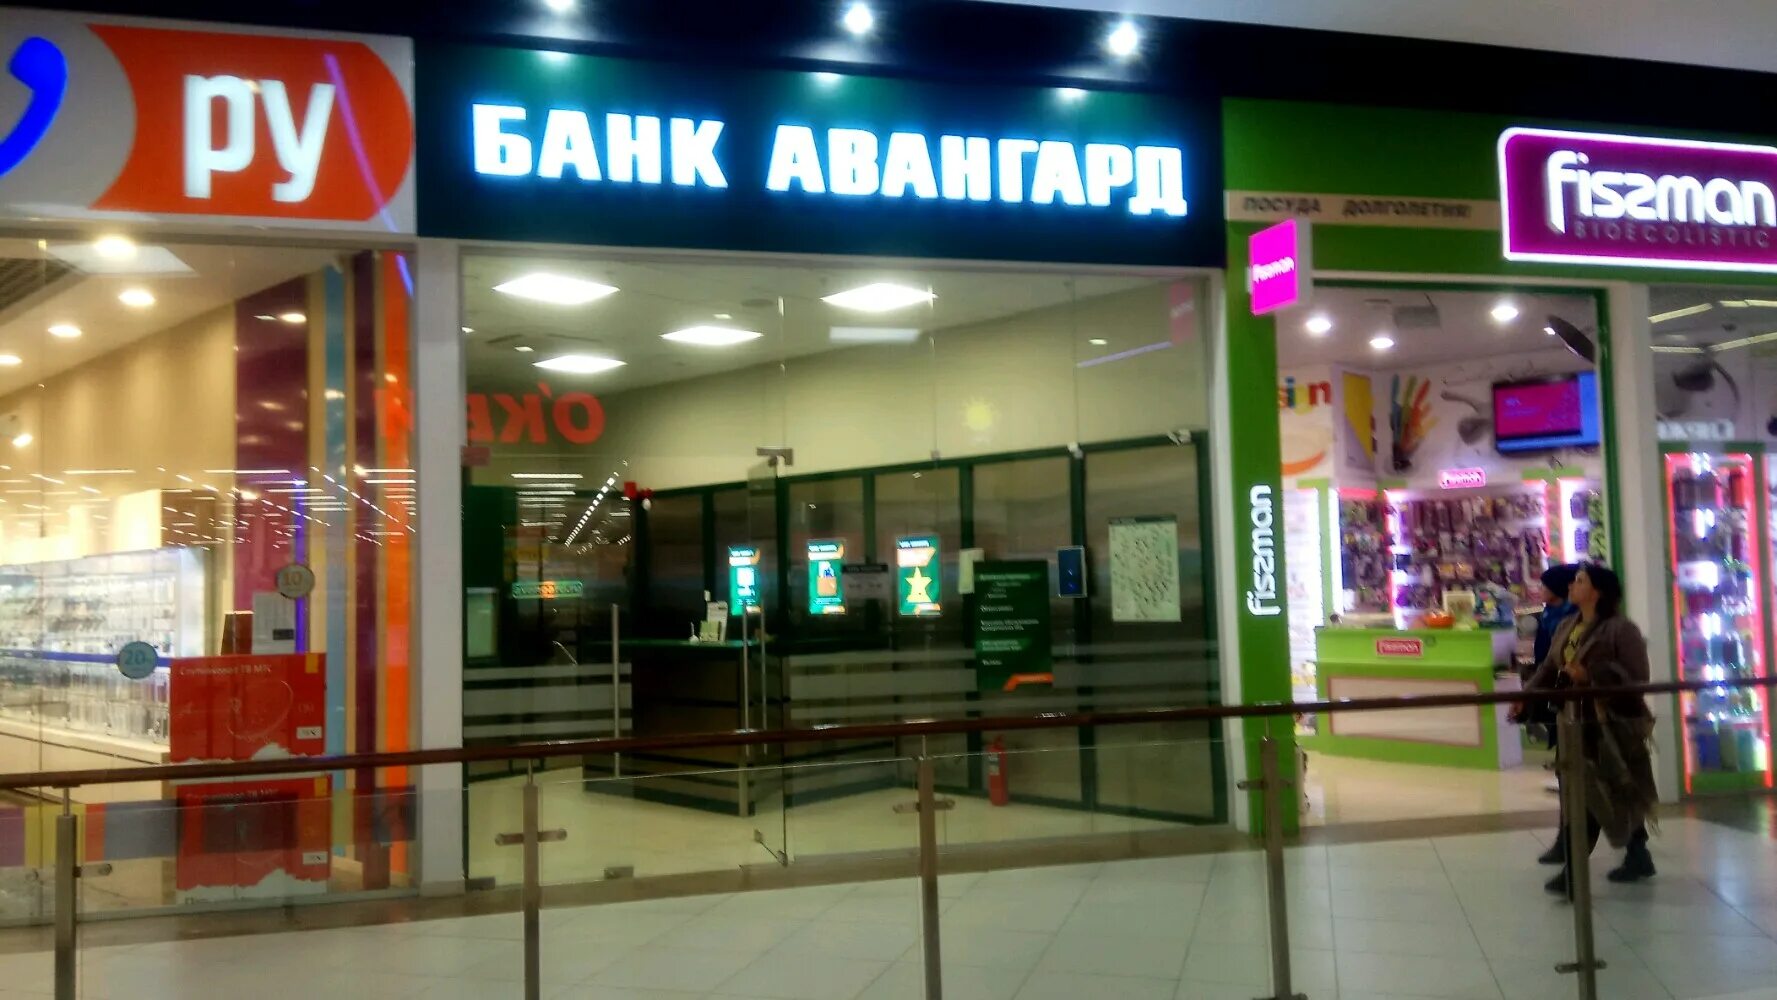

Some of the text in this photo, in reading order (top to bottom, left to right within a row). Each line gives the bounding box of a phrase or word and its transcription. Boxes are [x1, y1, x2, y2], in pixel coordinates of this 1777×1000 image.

[183, 73, 336, 204] ру
[472, 103, 1188, 217] БАНК АВАНГАРД
[1243, 196, 1322, 216] ПОСУДА
[1546, 149, 1777, 234] fiszman
[1572, 219, 1770, 249] BIOECOLISTIC
[1247, 484, 1281, 617] fiszman
